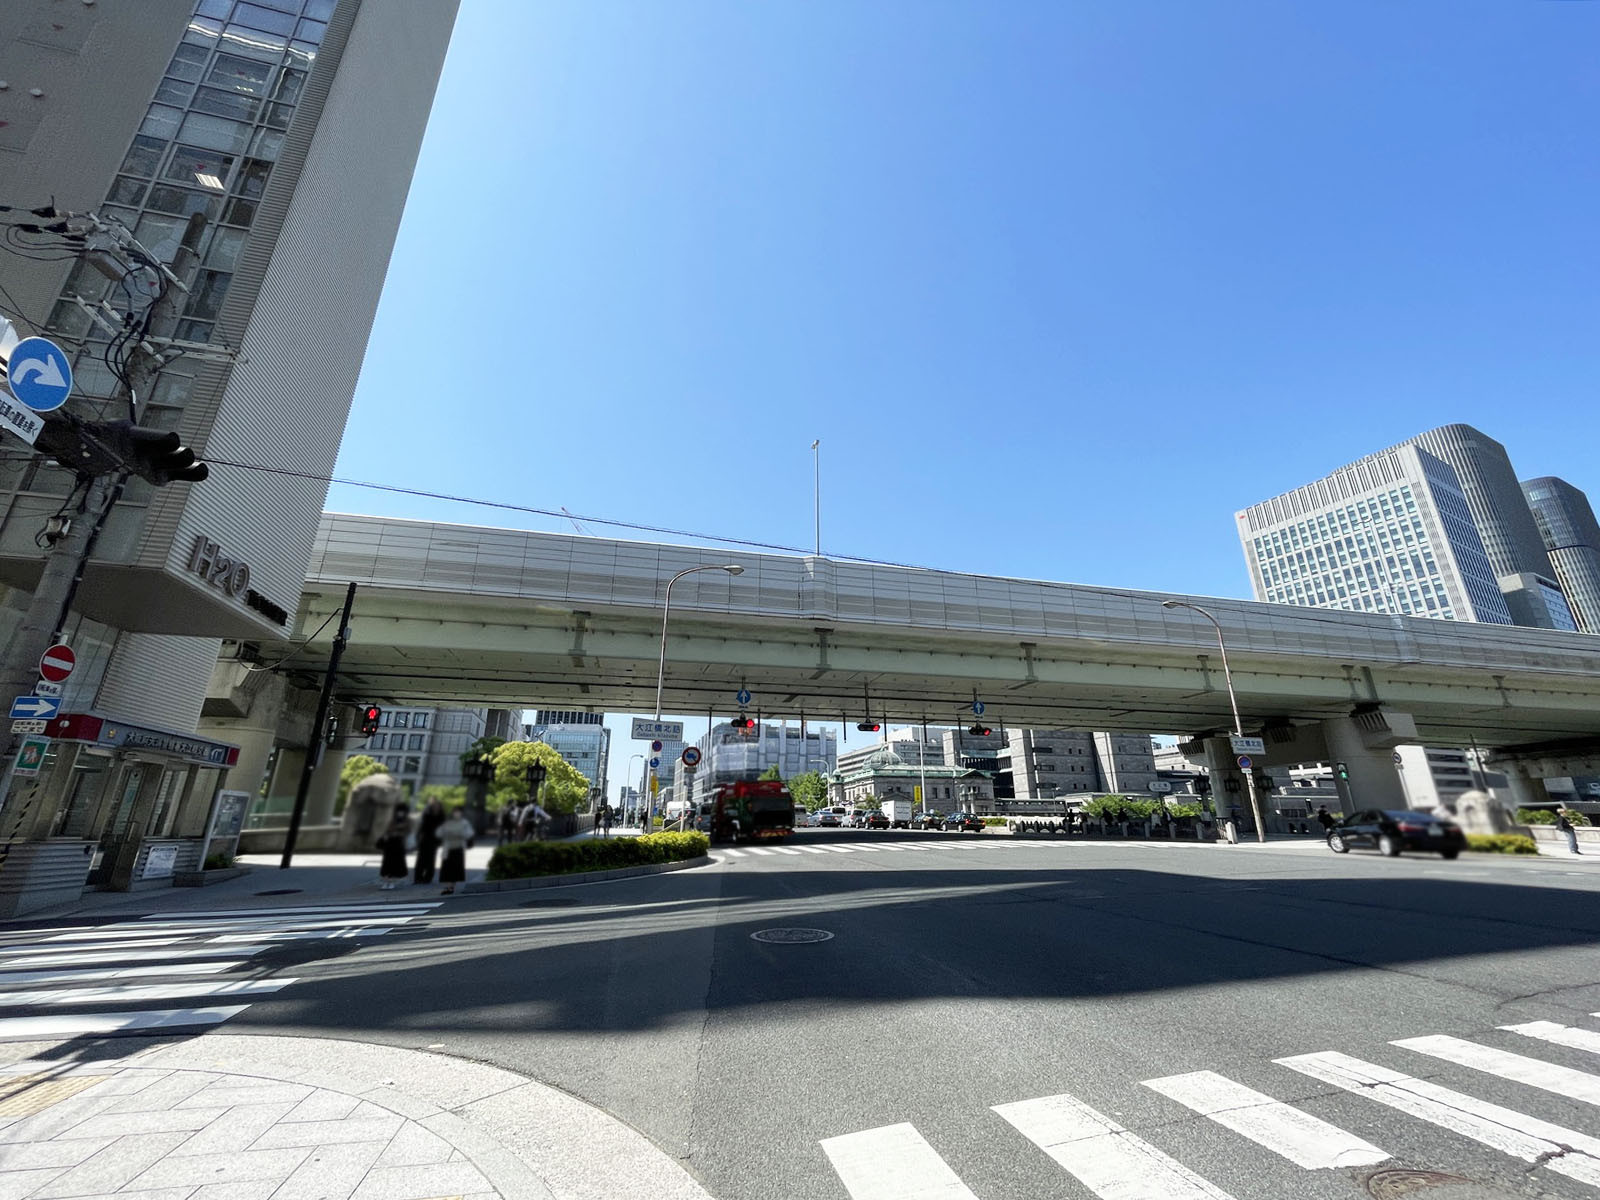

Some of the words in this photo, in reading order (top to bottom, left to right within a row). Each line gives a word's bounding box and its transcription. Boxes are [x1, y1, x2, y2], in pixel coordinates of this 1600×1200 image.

[188, 535, 250, 598] H2O
[635, 723, 680, 733] 大江橋北詰
